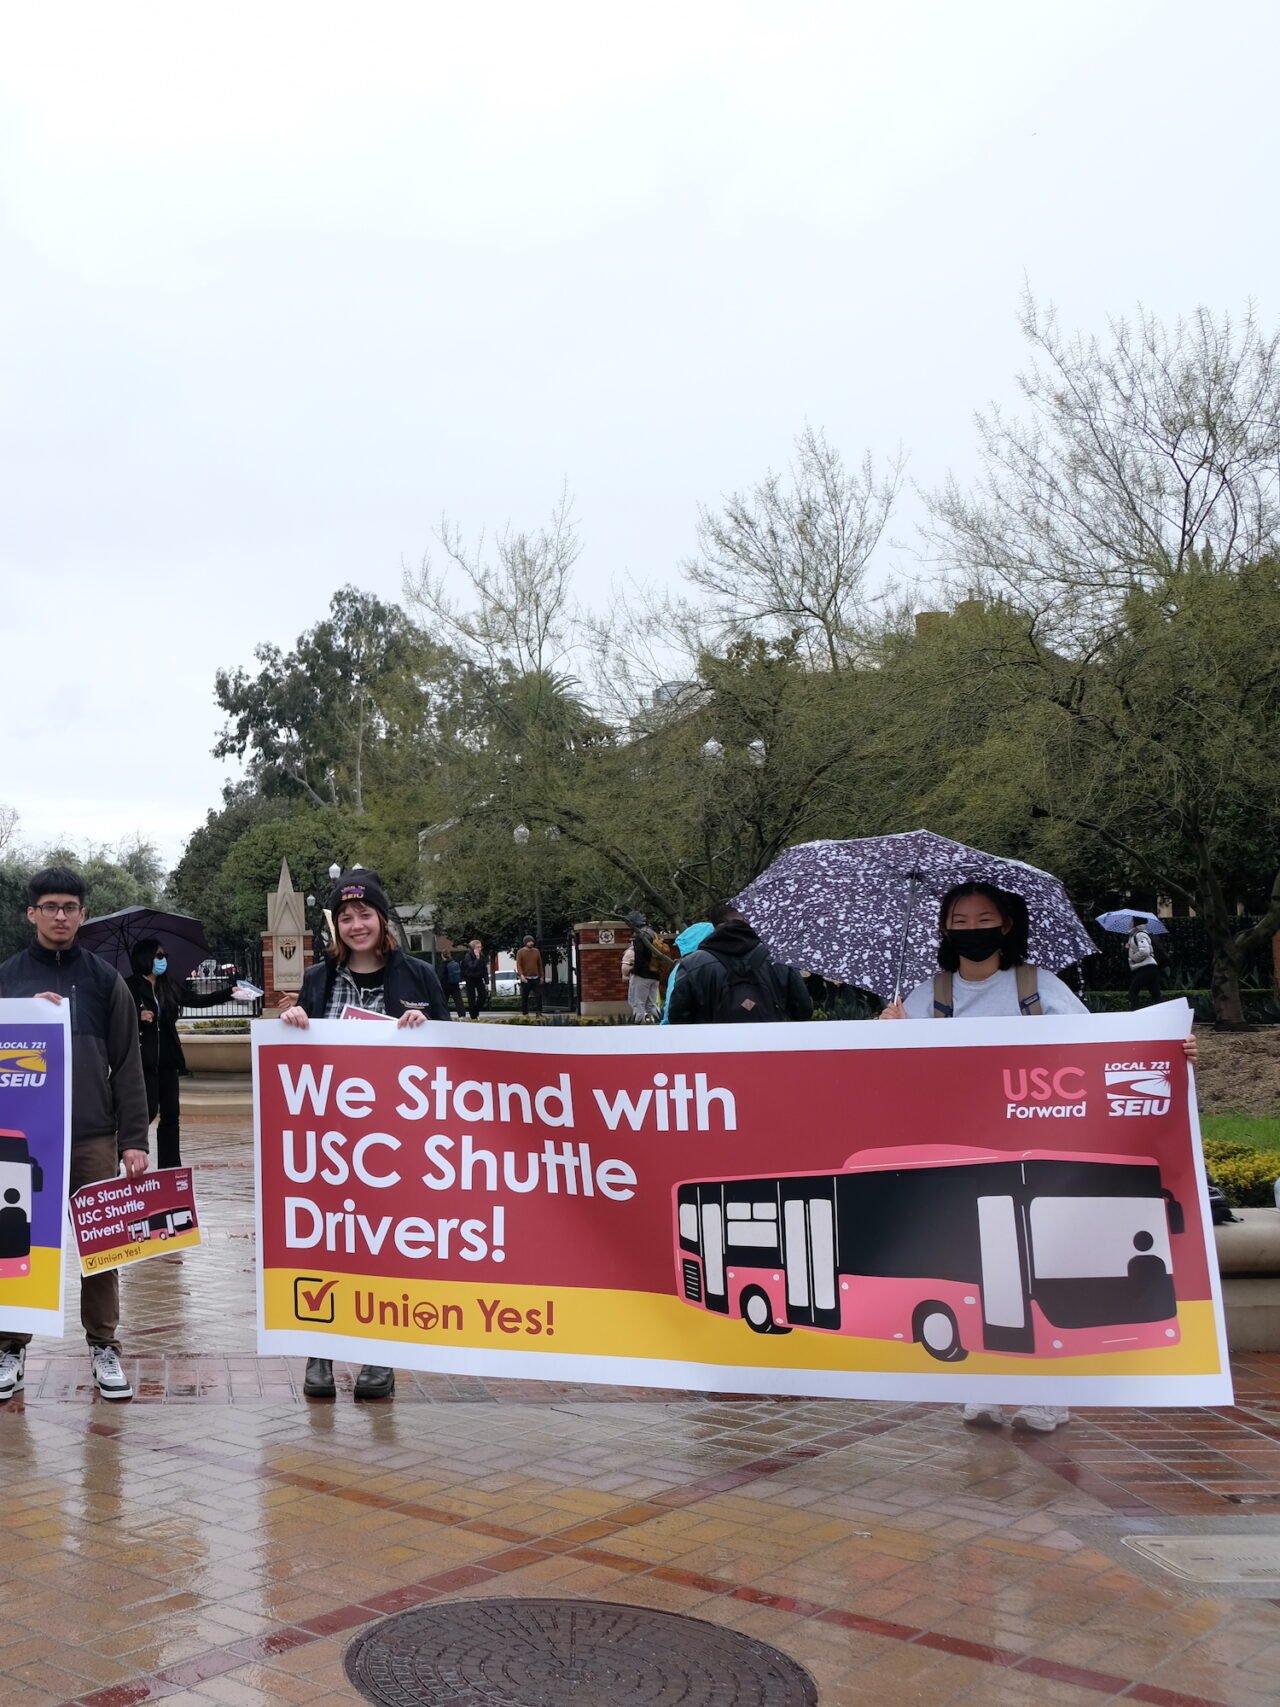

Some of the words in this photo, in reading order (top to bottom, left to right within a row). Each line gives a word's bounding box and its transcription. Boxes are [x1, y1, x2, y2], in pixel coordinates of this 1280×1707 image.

[31, 1041, 47, 1050] 721
[1104, 1061, 1147, 1072] LOCAL
[1150, 1060, 1171, 1071] 721
[1002, 1066, 1088, 1101] USC
[277, 1063, 376, 1118] We
[395, 1065, 575, 1128] Stand
[592, 1072, 737, 1131] with
[1108, 1098, 1171, 1118] SEIU
[1006, 1101, 1087, 1120] Forward
[282, 1130, 402, 1188] USC
[422, 1134, 638, 1201] Shuttle
[74, 1196, 95, 1210] We
[97, 1185, 132, 1204] Stand
[134, 1179, 161, 1194] with
[77, 1209, 103, 1226] USC
[105, 1200, 145, 1219] Shuttle
[81, 1220, 125, 1243] Drivers!
[284, 1197, 506, 1264] Drivers!
[124, 1246, 141, 1257] Yes!
[476, 1298, 555, 1336] Yes!
